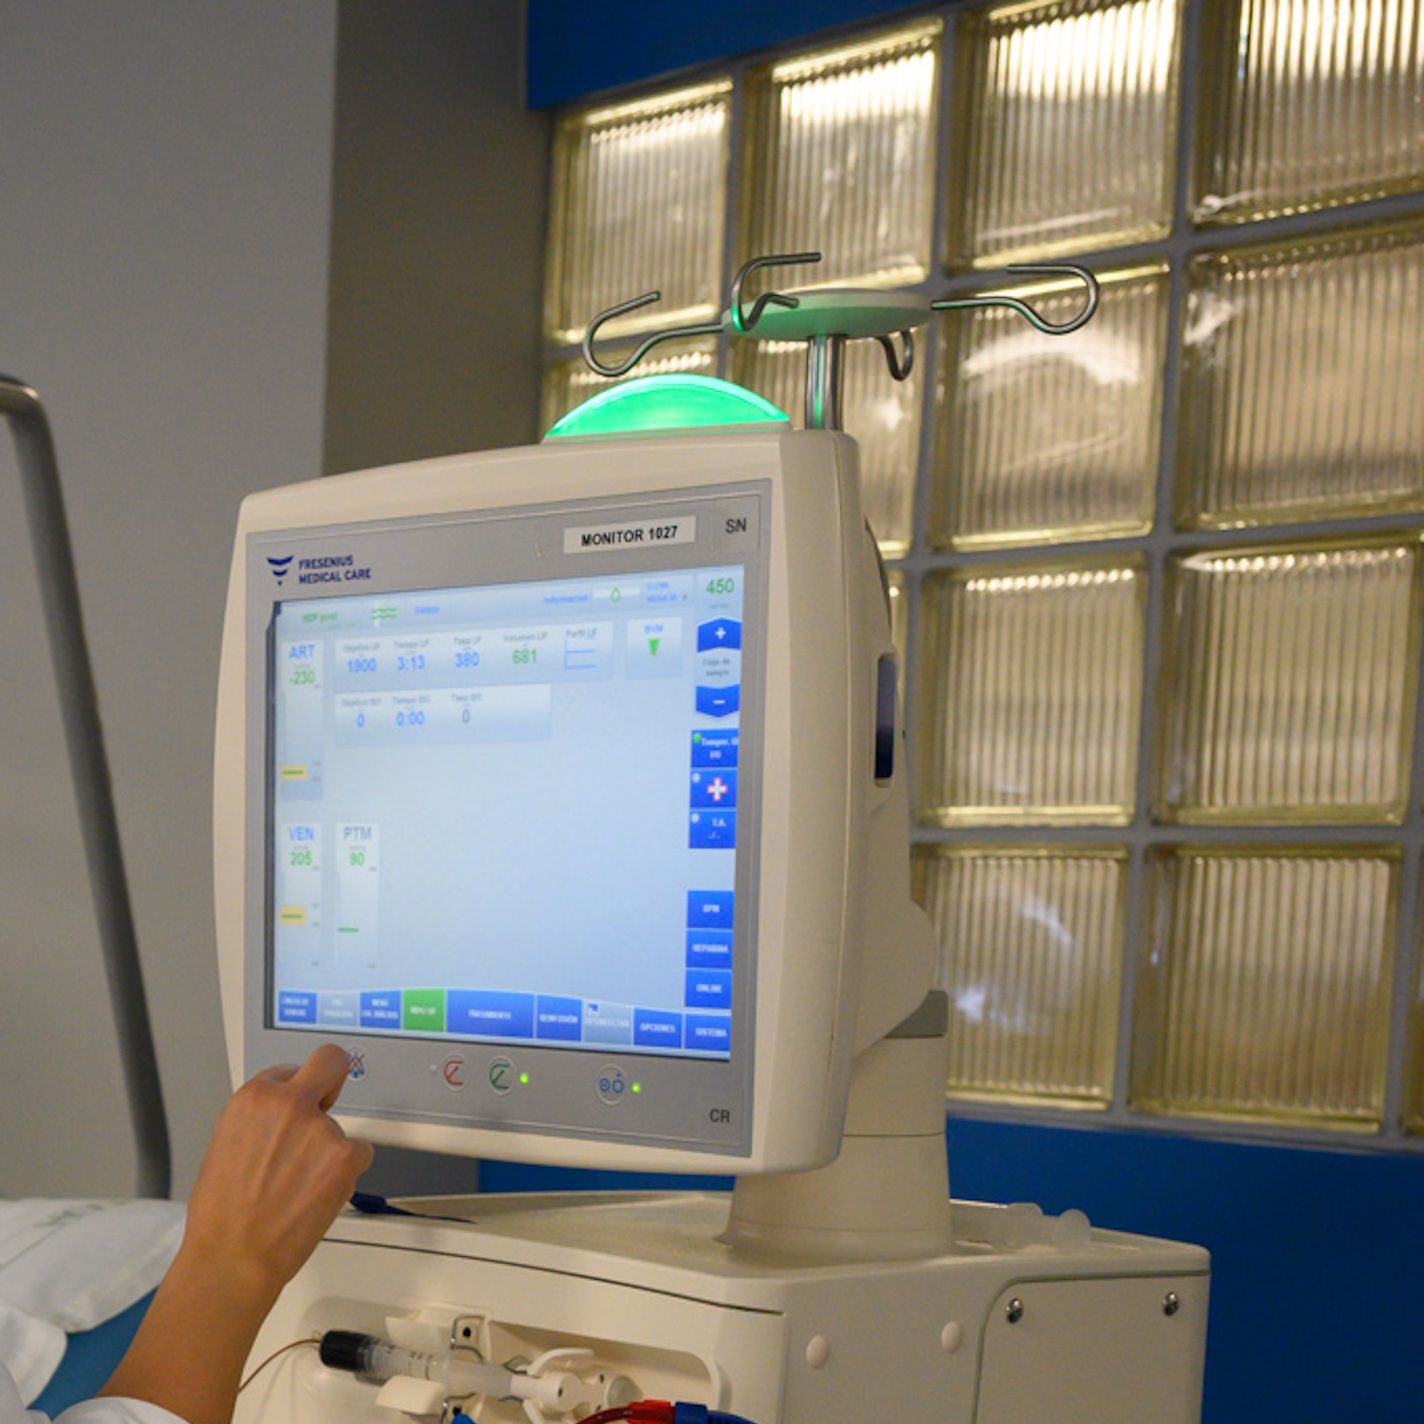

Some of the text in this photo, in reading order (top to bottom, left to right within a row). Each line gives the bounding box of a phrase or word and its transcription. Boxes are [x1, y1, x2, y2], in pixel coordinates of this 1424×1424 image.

[725, 518, 747, 534] SN
[581, 525, 679, 546] MONITOR 1027
[299, 555, 354, 570] FRESENIUS
[299, 568, 371, 584] MEDICAL CARE
[706, 578, 735, 594] 450
[289, 644, 315, 659] ART
[512, 649, 538, 664] 681
[397, 655, 426, 671] 3:13
[455, 652, 480, 668] 380
[356, 713, 365, 728] 0
[396, 711, 425, 726] 0:00
[462, 709, 470, 724] 0
[289, 826, 315, 841] VEN
[344, 826, 372, 841] PTM
[290, 851, 313, 866] 205
[709, 1108, 730, 1123] CR
